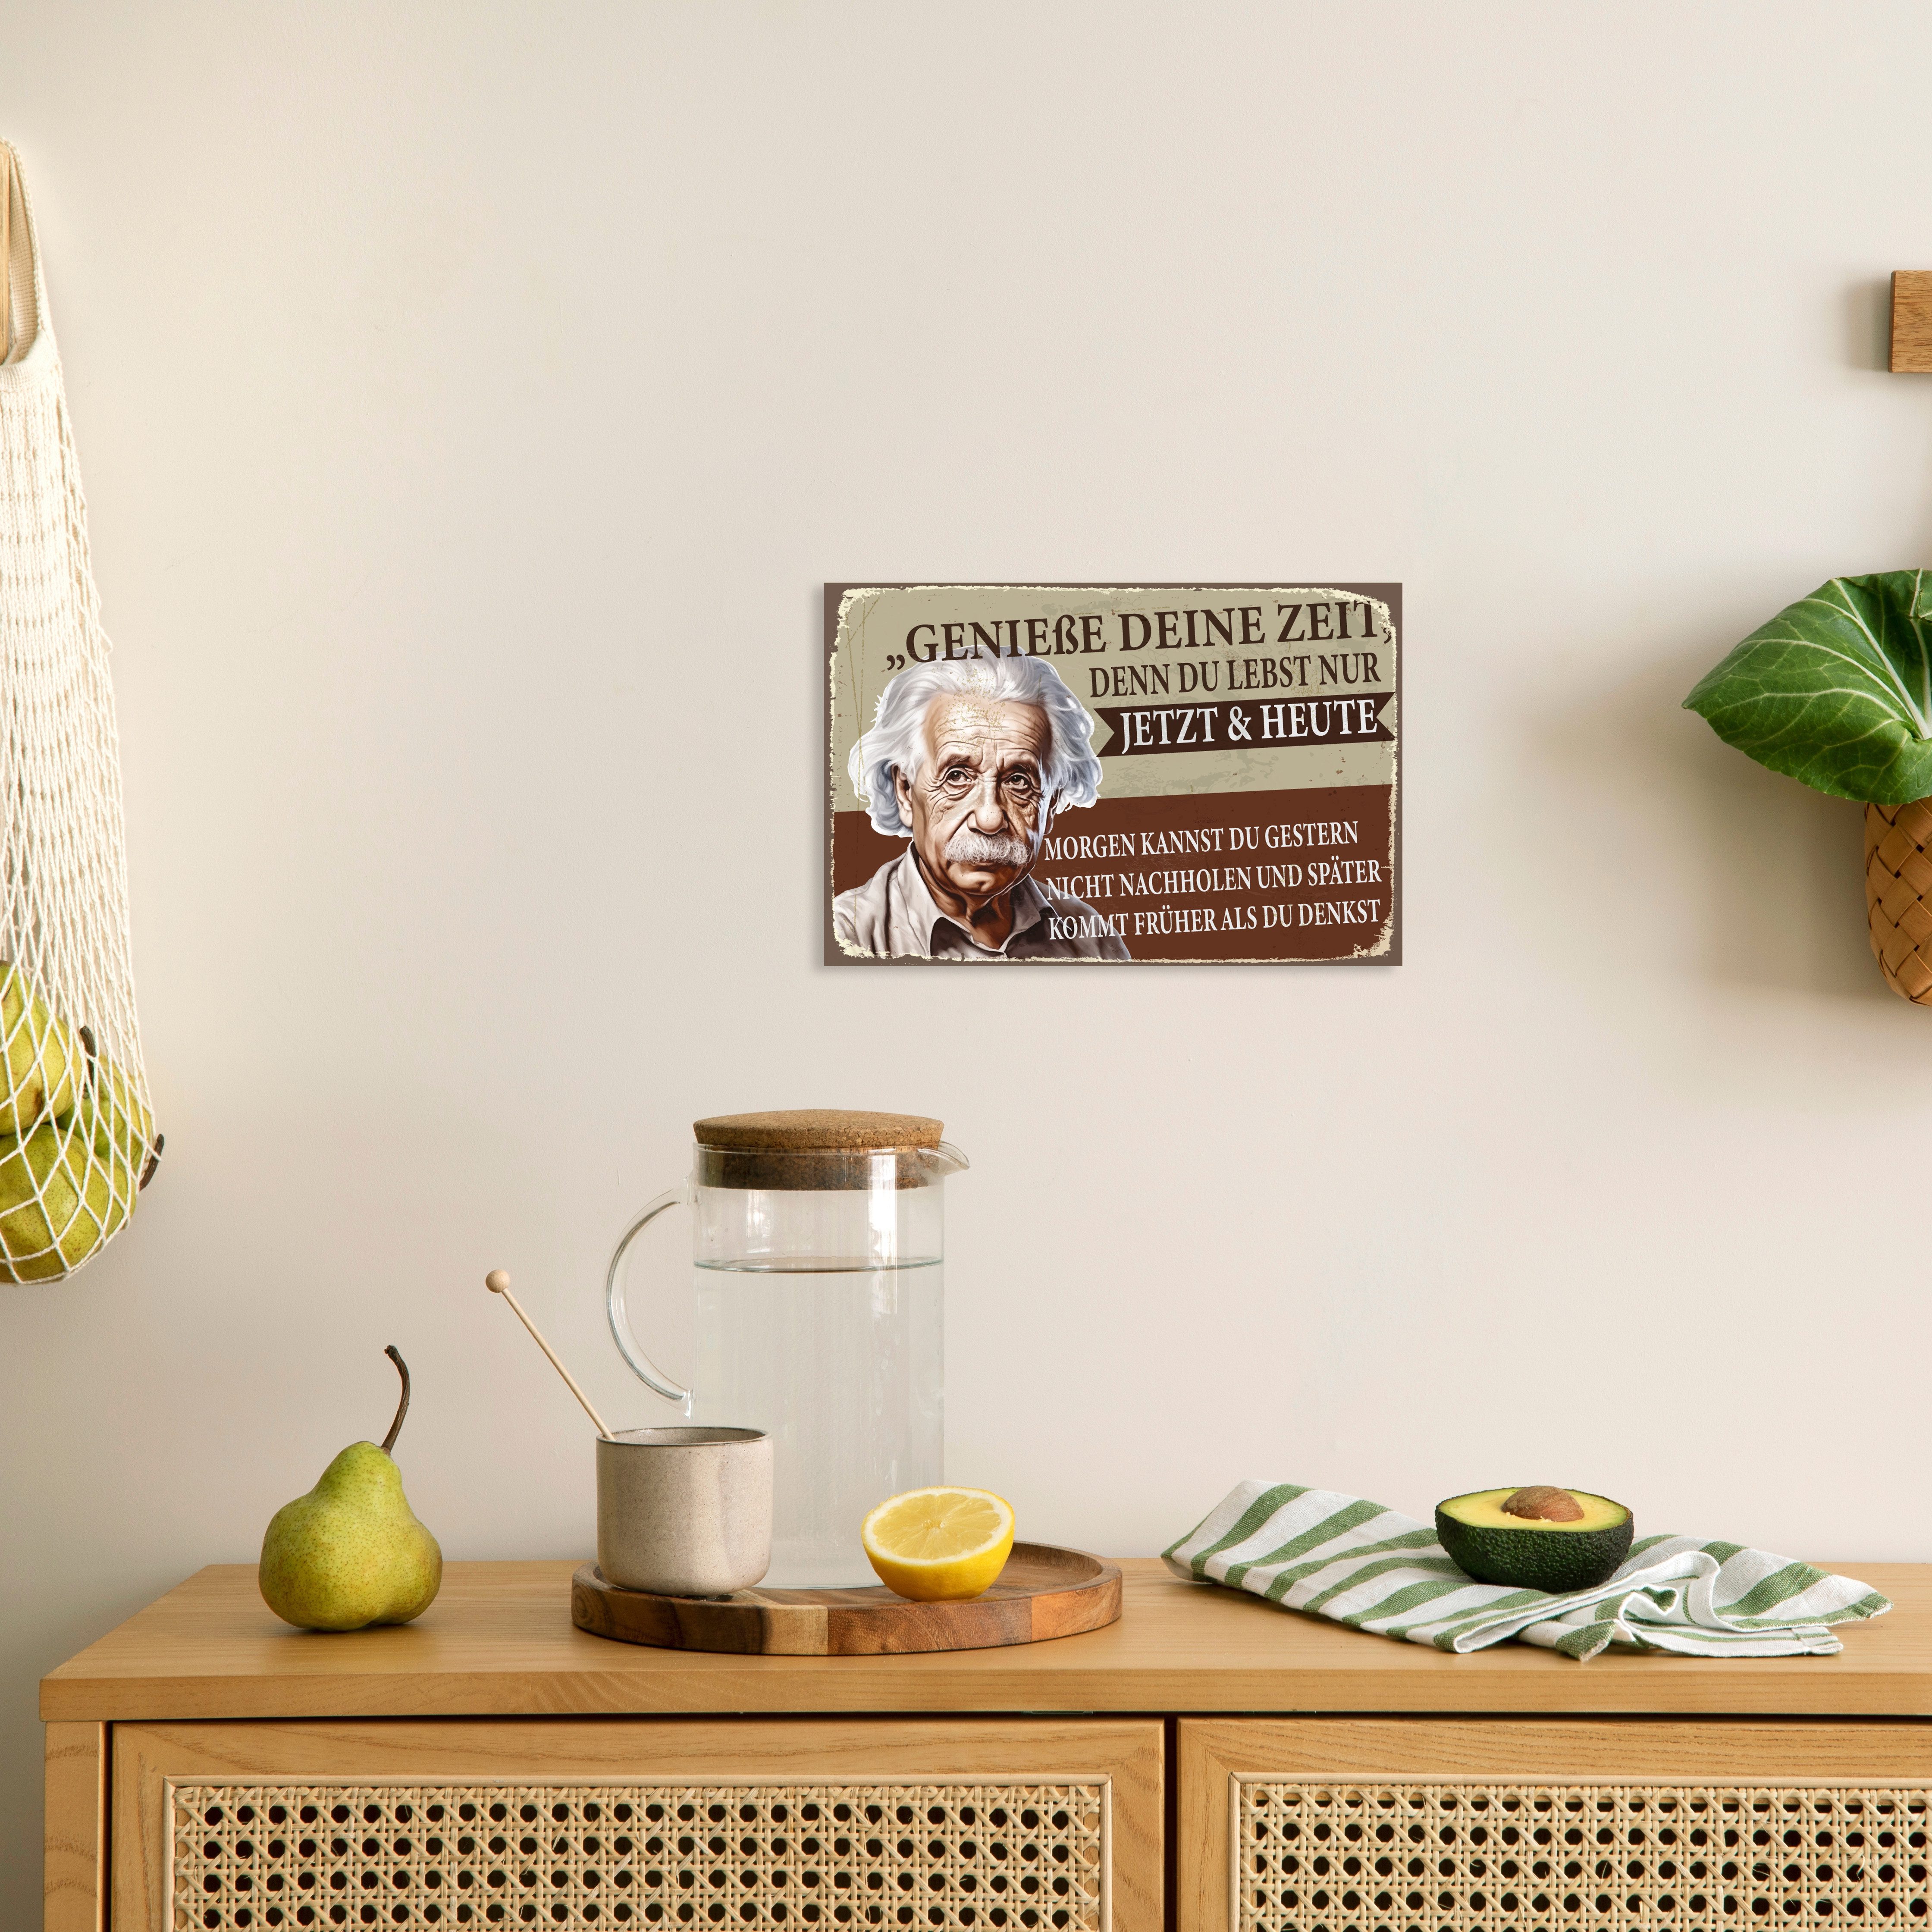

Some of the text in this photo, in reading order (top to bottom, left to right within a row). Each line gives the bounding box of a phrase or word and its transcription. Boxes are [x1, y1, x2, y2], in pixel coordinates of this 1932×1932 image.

[1118, 606, 1265, 651] DEINE
[1277, 601, 1392, 644] ZEIT,
[1089, 652, 1381, 697] DENN DU LEBST NUR
[1120, 699, 1377, 755] JETZT & HEUTE
[1044, 821, 1358, 860] MORGEN KANNST DU GESTERN
[1046, 855, 1382, 900] NICHT NACHHOLEN UND SPÄTER
[1048, 899, 1380, 940] KOMMT FRÜHER ALS DU DENKST
